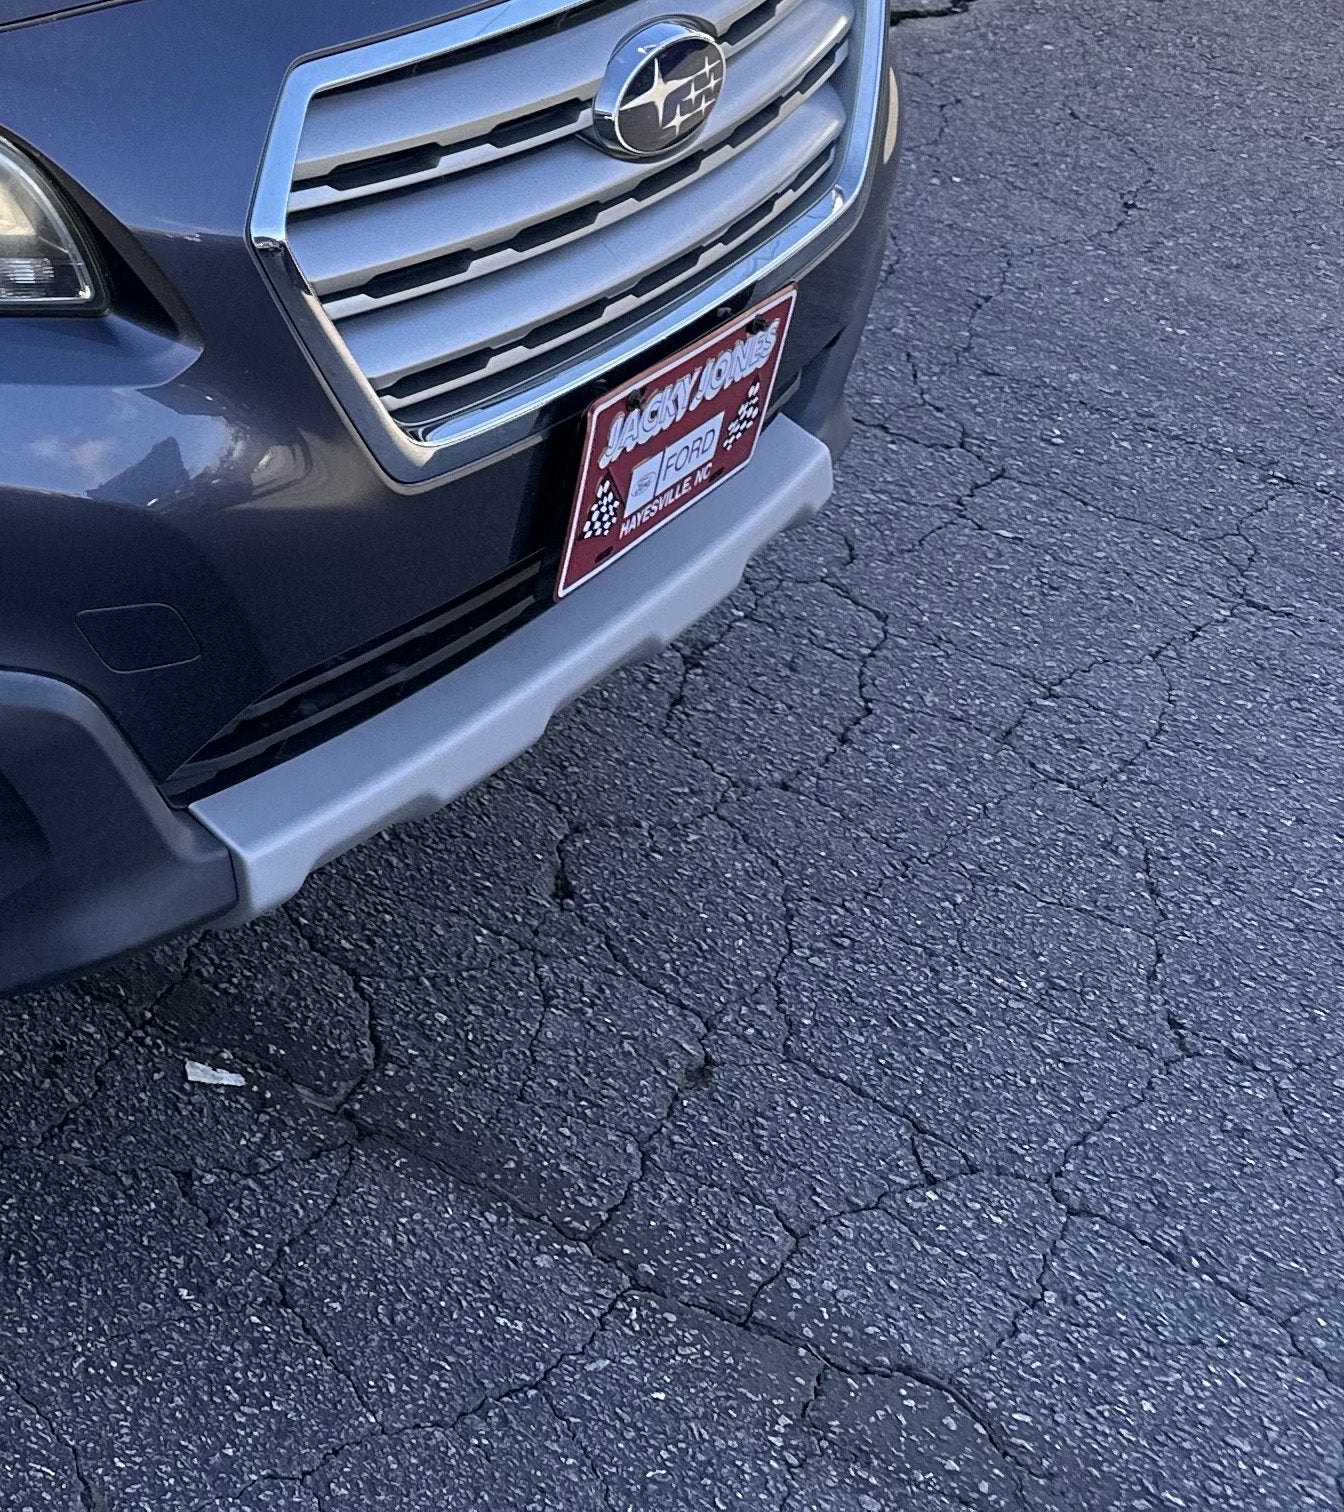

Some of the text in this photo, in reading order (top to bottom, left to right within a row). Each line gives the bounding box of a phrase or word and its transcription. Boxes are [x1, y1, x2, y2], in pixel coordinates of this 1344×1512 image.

[598, 318, 780, 469] JACKY JONES
[662, 427, 716, 482] FORD
[693, 461, 713, 487] NC
